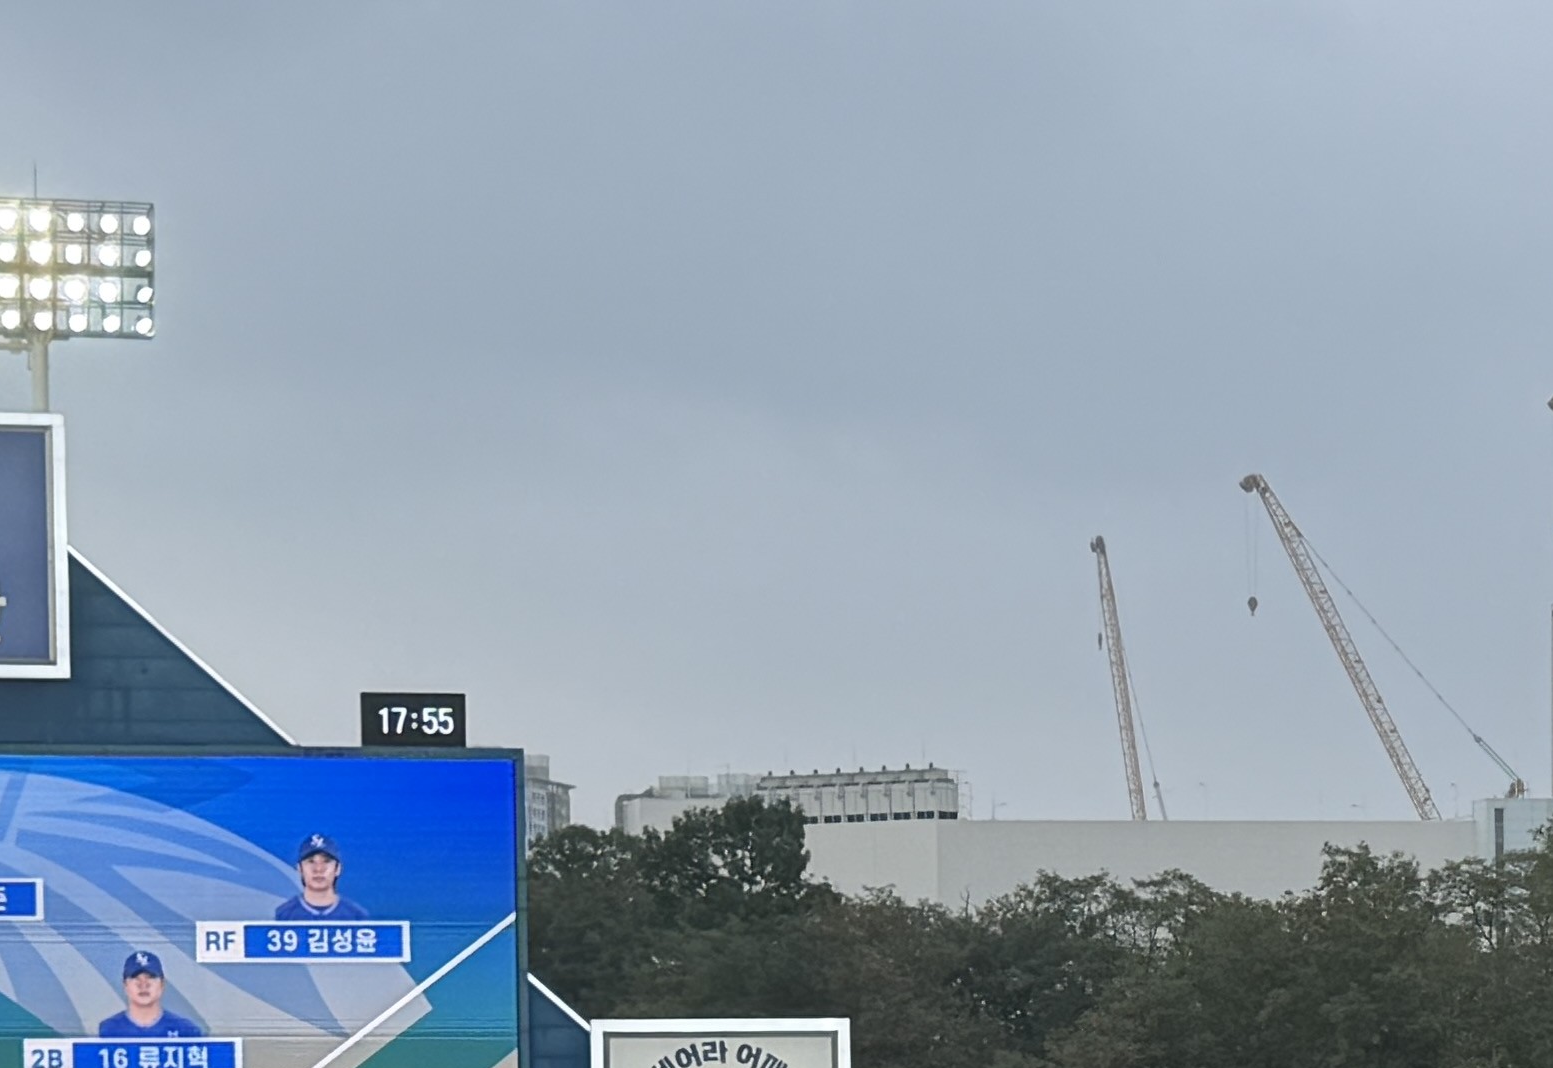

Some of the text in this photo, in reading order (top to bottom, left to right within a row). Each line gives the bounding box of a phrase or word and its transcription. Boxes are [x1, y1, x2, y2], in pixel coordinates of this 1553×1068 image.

[378, 707, 455, 735] 17:55
[205, 927, 378, 955] RF 39 김성윤
